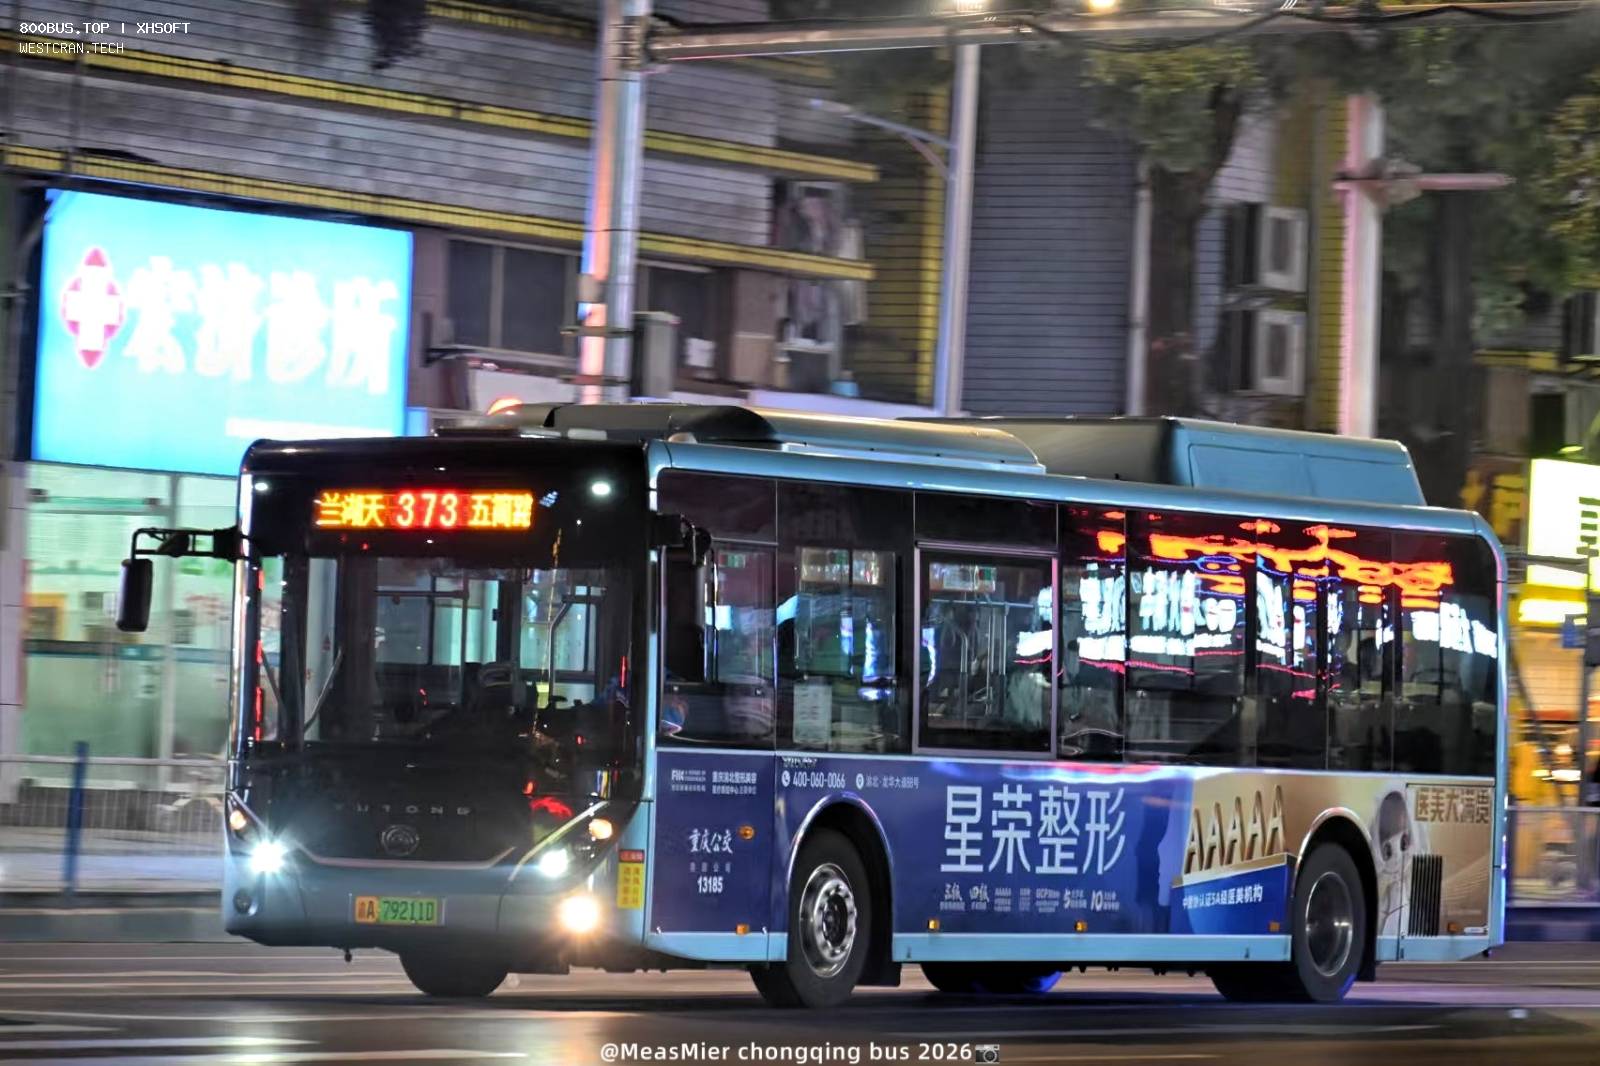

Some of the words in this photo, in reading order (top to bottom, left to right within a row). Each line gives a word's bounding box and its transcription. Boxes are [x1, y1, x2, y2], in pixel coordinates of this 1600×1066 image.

[396, 492, 459, 528] 373
[792, 771, 847, 789] 400-060-0066
[688, 827, 734, 855] 重庆公交
[939, 783, 1127, 876] 星荣整形
[1182, 784, 1286, 876] AAAAA
[696, 875, 724, 894] 13185
